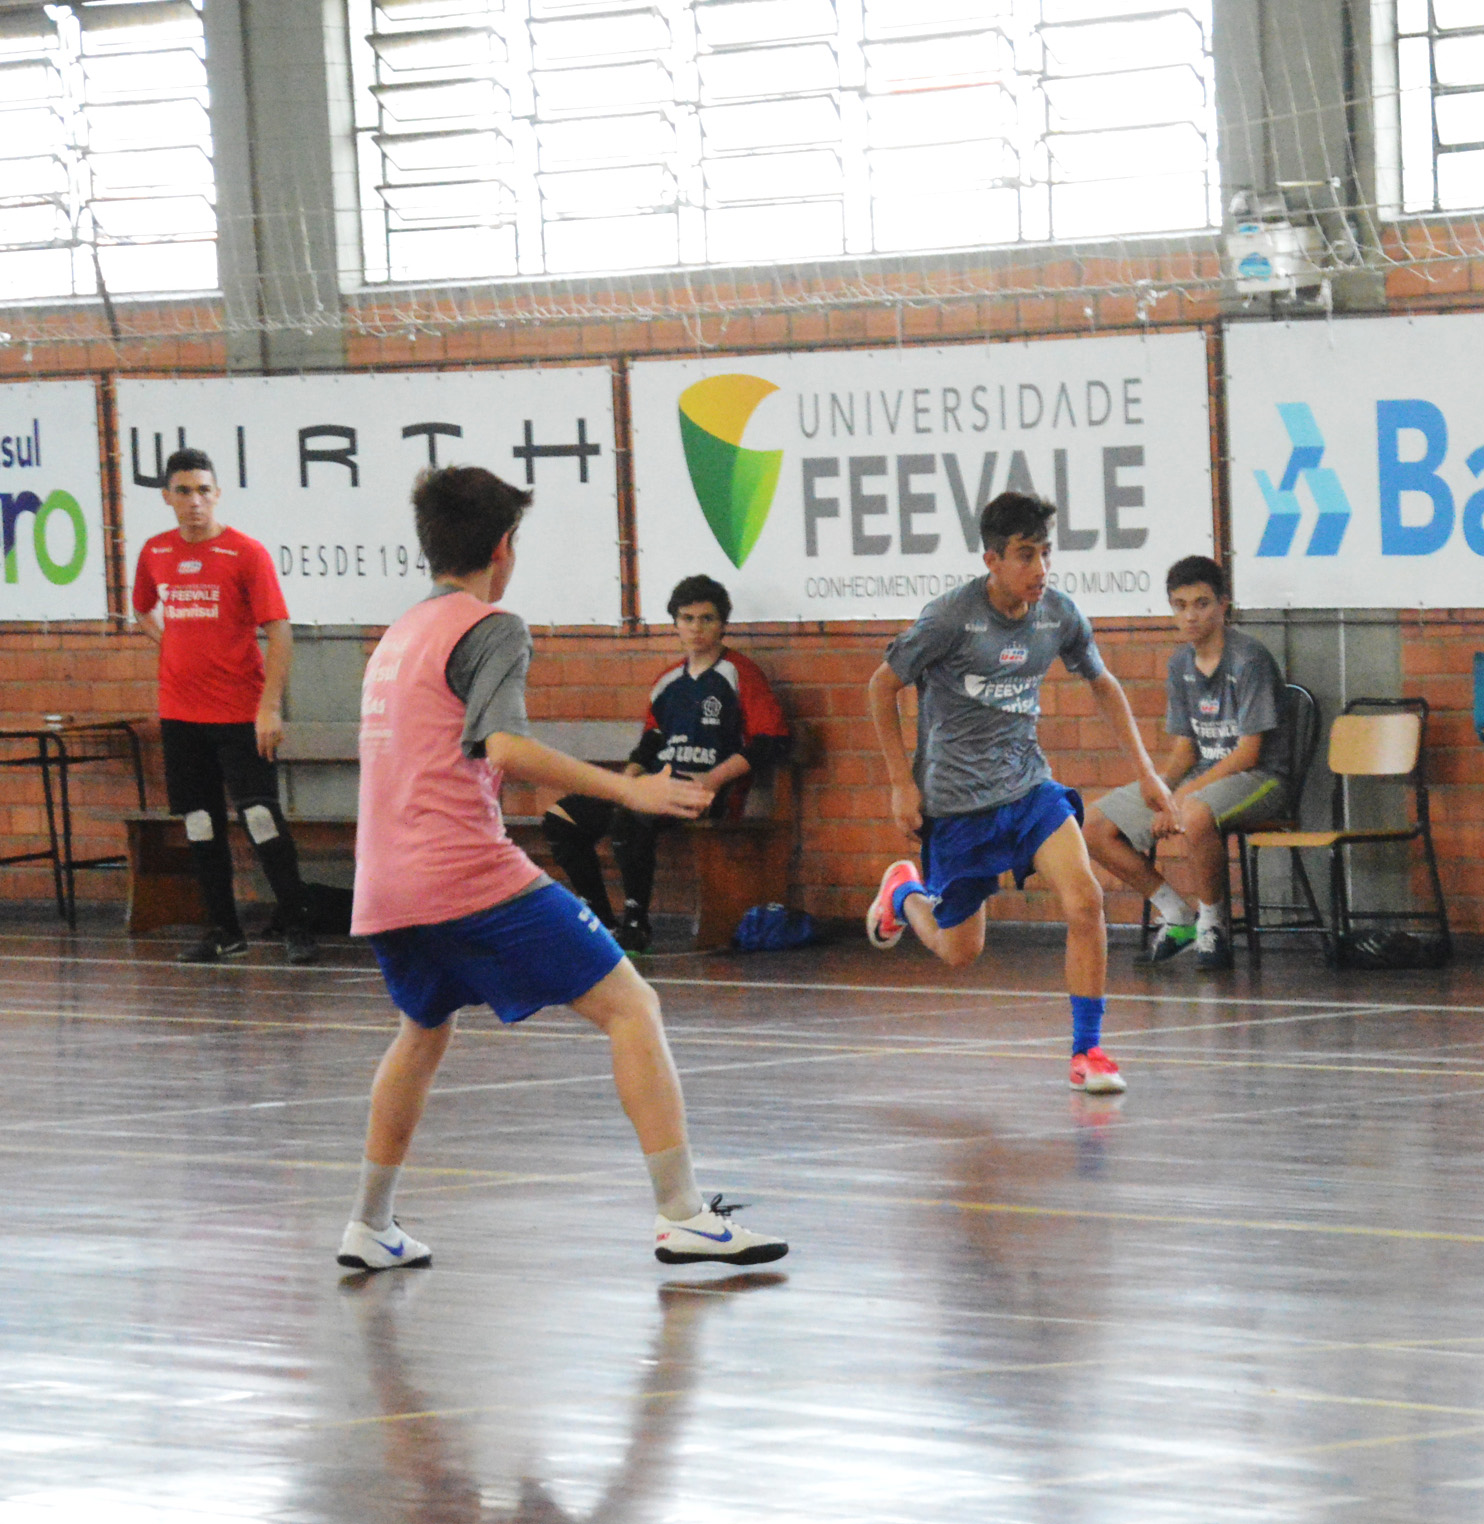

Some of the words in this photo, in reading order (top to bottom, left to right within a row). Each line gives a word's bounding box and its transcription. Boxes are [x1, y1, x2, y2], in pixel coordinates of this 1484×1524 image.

[798, 377, 1144, 439] UNIVERSIDADE
[131, 418, 600, 488] WIRTH
[280, 544, 367, 577] DESDE
[379, 544, 427, 577] 194
[806, 574, 941, 600] CONHECIMENTO
[1082, 570, 1151, 594] MUNDO
